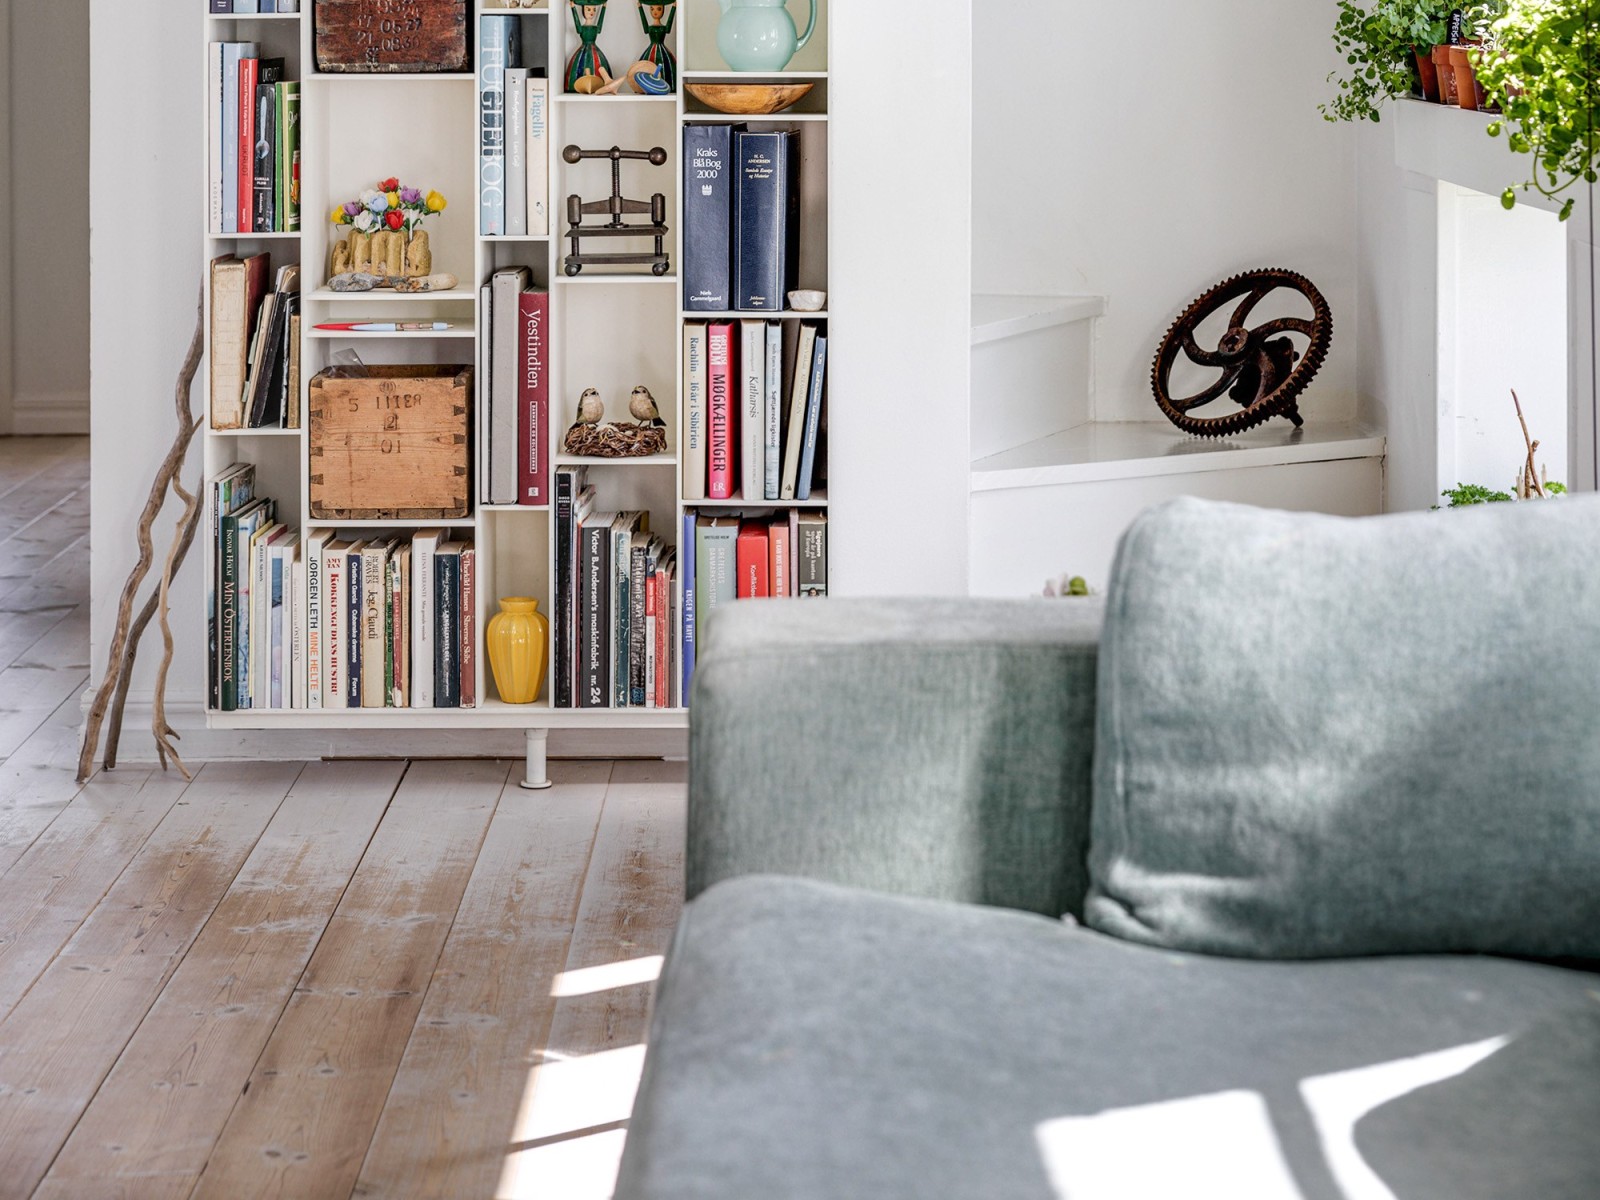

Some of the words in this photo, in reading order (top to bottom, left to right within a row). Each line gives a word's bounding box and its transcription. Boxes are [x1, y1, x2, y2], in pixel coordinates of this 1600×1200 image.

[481, 46, 503, 207] FUGLEBOG
[530, 94, 545, 138] Fågelliv
[693, 159, 706, 168] Blå
[706, 159, 722, 170] Bog
[696, 148, 718, 157] Kraks
[696, 170, 718, 178] 2000
[520, 309, 541, 388] Vestindien
[690, 337, 699, 372] Rachlin
[710, 335, 721, 366] HOLM
[690, 383, 699, 392] 16
[749, 376, 759, 418] Katharsis
[348, 398, 359, 412] 5
[690, 412, 699, 449] Sibirien
[712, 374, 725, 472] MØGKÆLLINGER
[226, 529, 235, 553] INGVAR
[226, 555, 234, 576] HOLM
[309, 557, 318, 600] JØRGEN
[463, 559, 471, 586] Thorkild
[224, 582, 235, 605] MIN
[463, 587, 471, 612] Hansen
[309, 602, 318, 628] LETH
[686, 614, 693, 622] PÅ
[463, 615, 471, 644] Slavernes
[591, 614, 599, 670] maskinfabrik
[223, 608, 237, 682] ÖSTERLENBOK
[310, 631, 318, 656] MINE
[463, 646, 471, 664] Skibe
[310, 659, 318, 690] HELTE
[590, 688, 601, 704] 24
